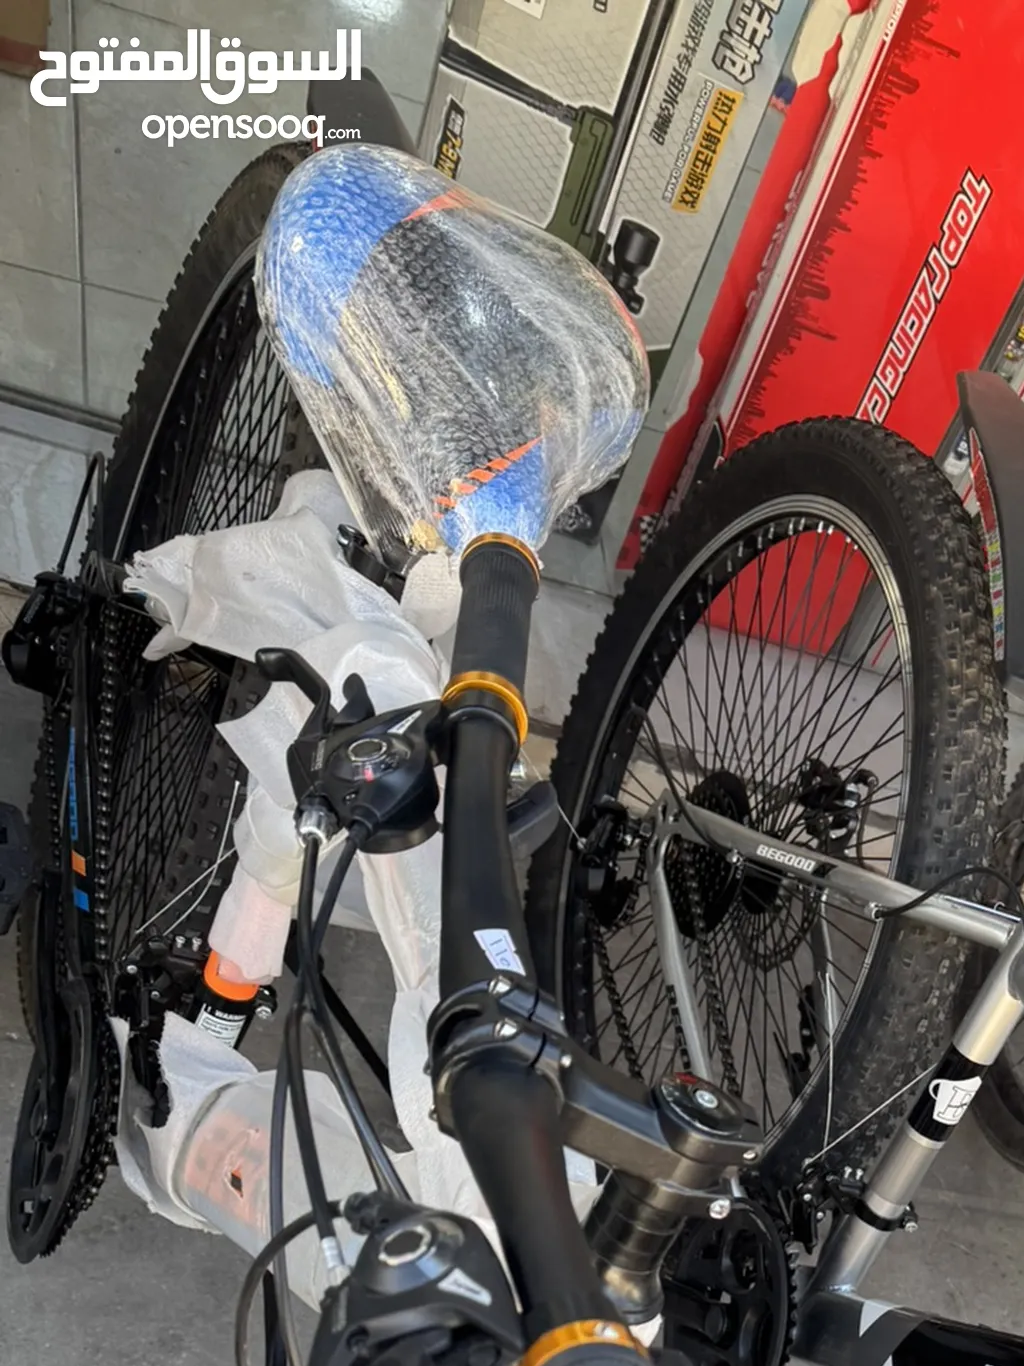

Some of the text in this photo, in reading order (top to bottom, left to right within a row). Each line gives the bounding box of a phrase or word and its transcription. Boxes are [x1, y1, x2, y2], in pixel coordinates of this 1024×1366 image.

[685, 80, 714, 143] POWERFUL
[677, 144, 691, 167] FOR
[678, 91, 736, 209] 热力射击游戏
[940, 166, 993, 268] TOP
[756, 843, 817, 873] BEGOOD
